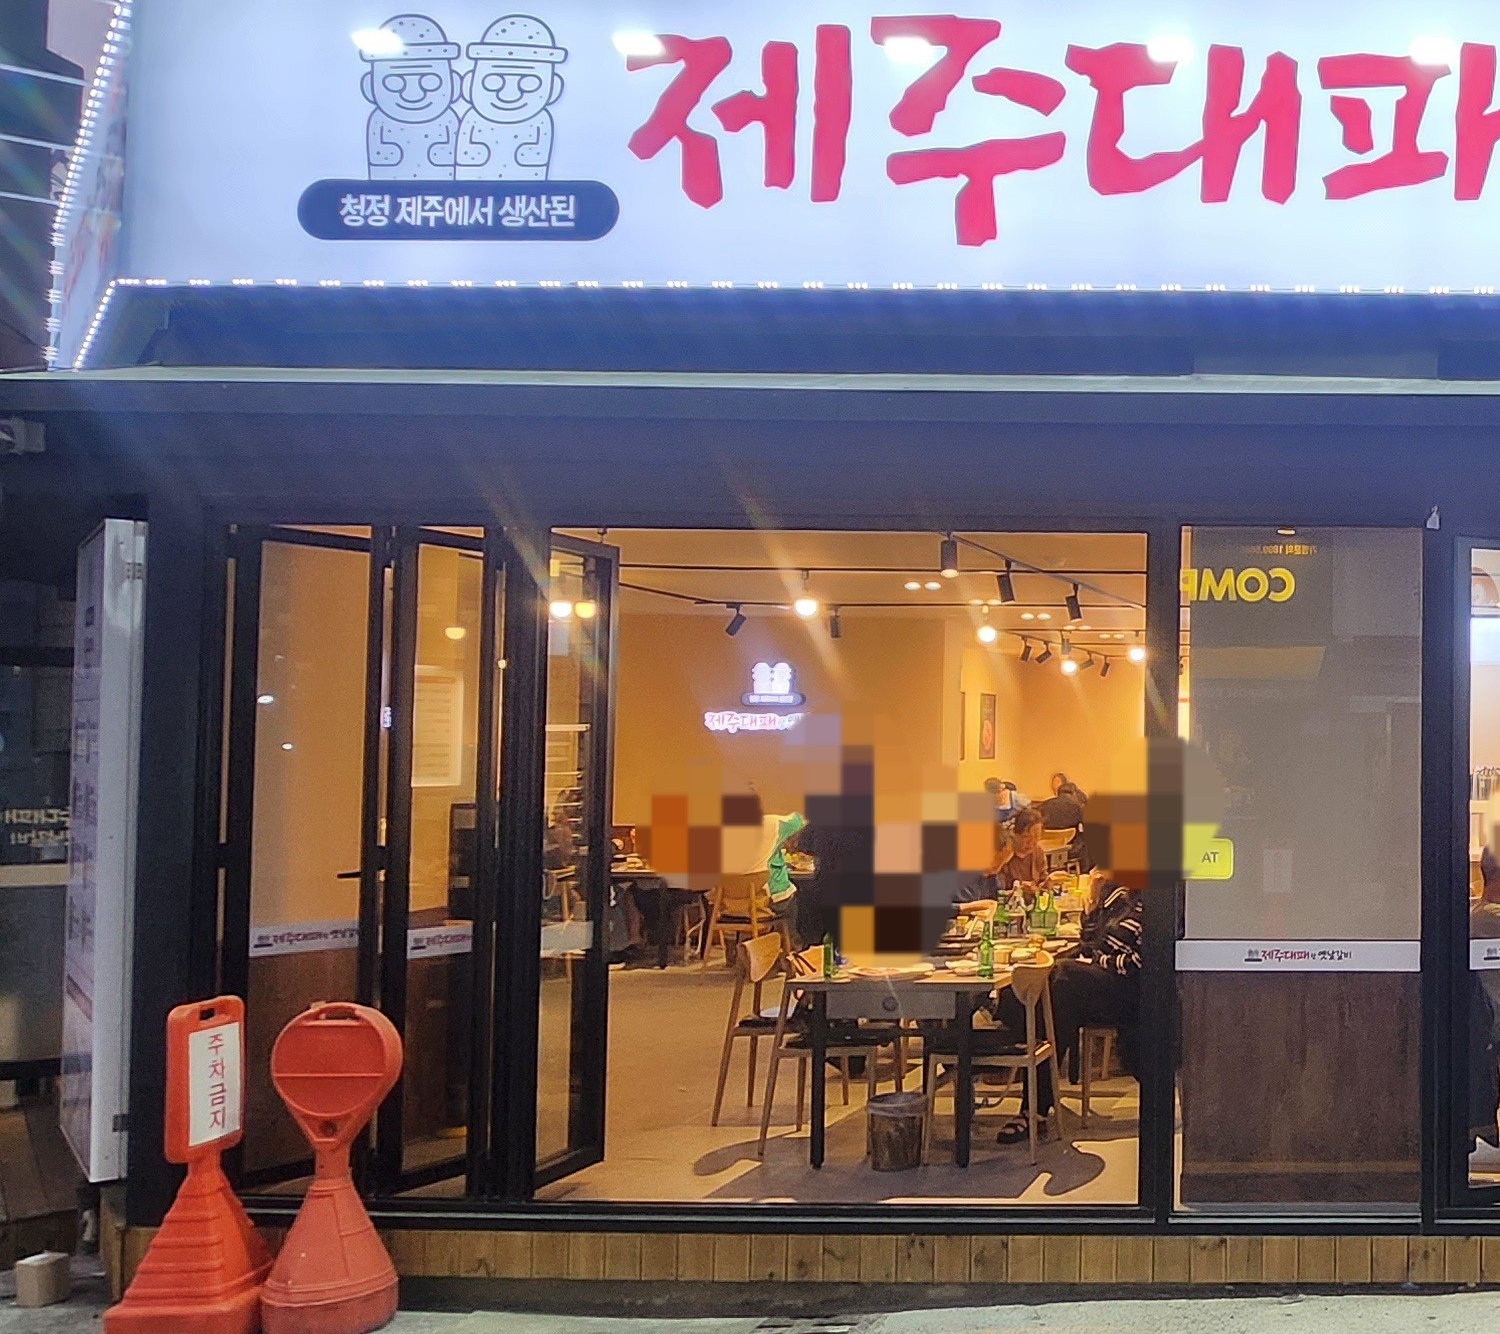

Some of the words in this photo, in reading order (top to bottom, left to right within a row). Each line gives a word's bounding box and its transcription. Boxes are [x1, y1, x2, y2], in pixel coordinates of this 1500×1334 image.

[340, 194, 391, 227] 청정
[395, 195, 494, 227] 제주에서
[499, 195, 576, 227] 생산된
[208, 1033, 227, 1129] 주차금지
